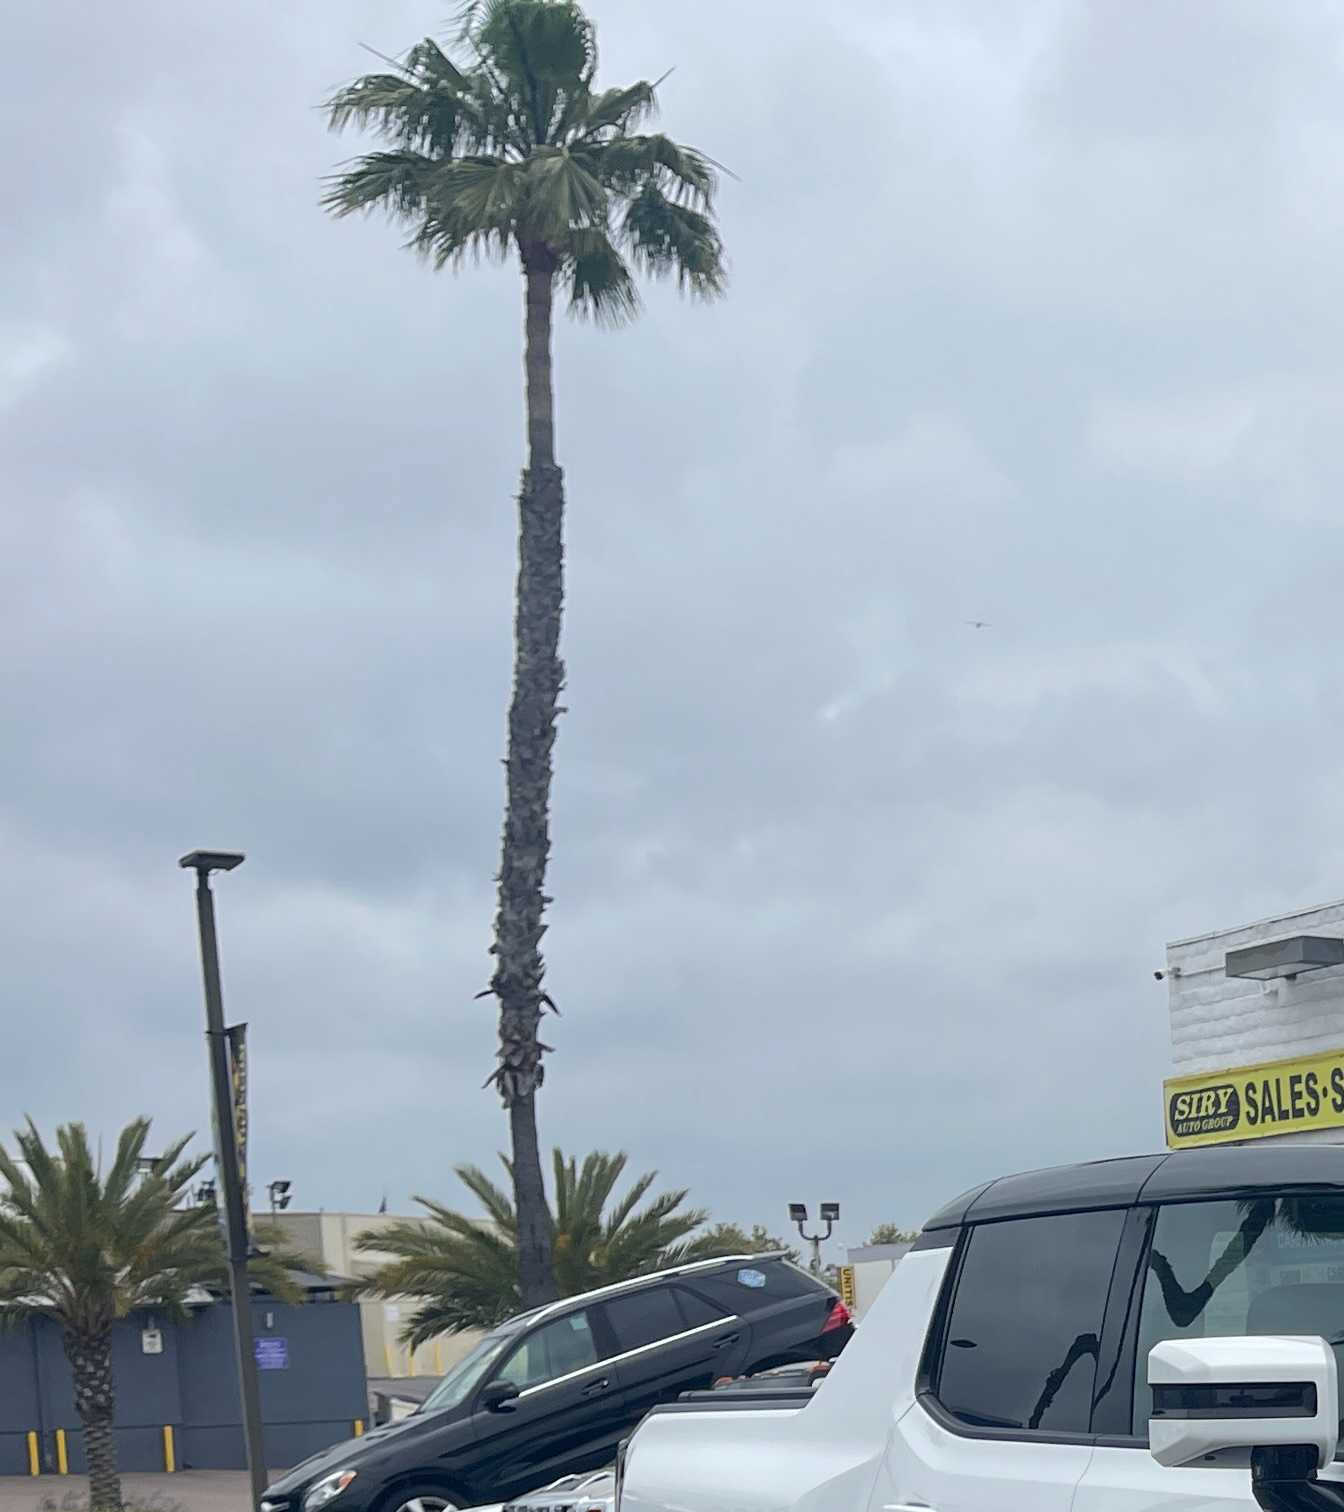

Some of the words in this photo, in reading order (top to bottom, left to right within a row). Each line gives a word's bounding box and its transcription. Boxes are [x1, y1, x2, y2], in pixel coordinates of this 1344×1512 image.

[1174, 1087, 1234, 1121] SIRY
[1245, 1072, 1320, 1126] SALES
[1176, 1119, 1201, 1135] AUTO
[1202, 1115, 1234, 1131] GROUP
